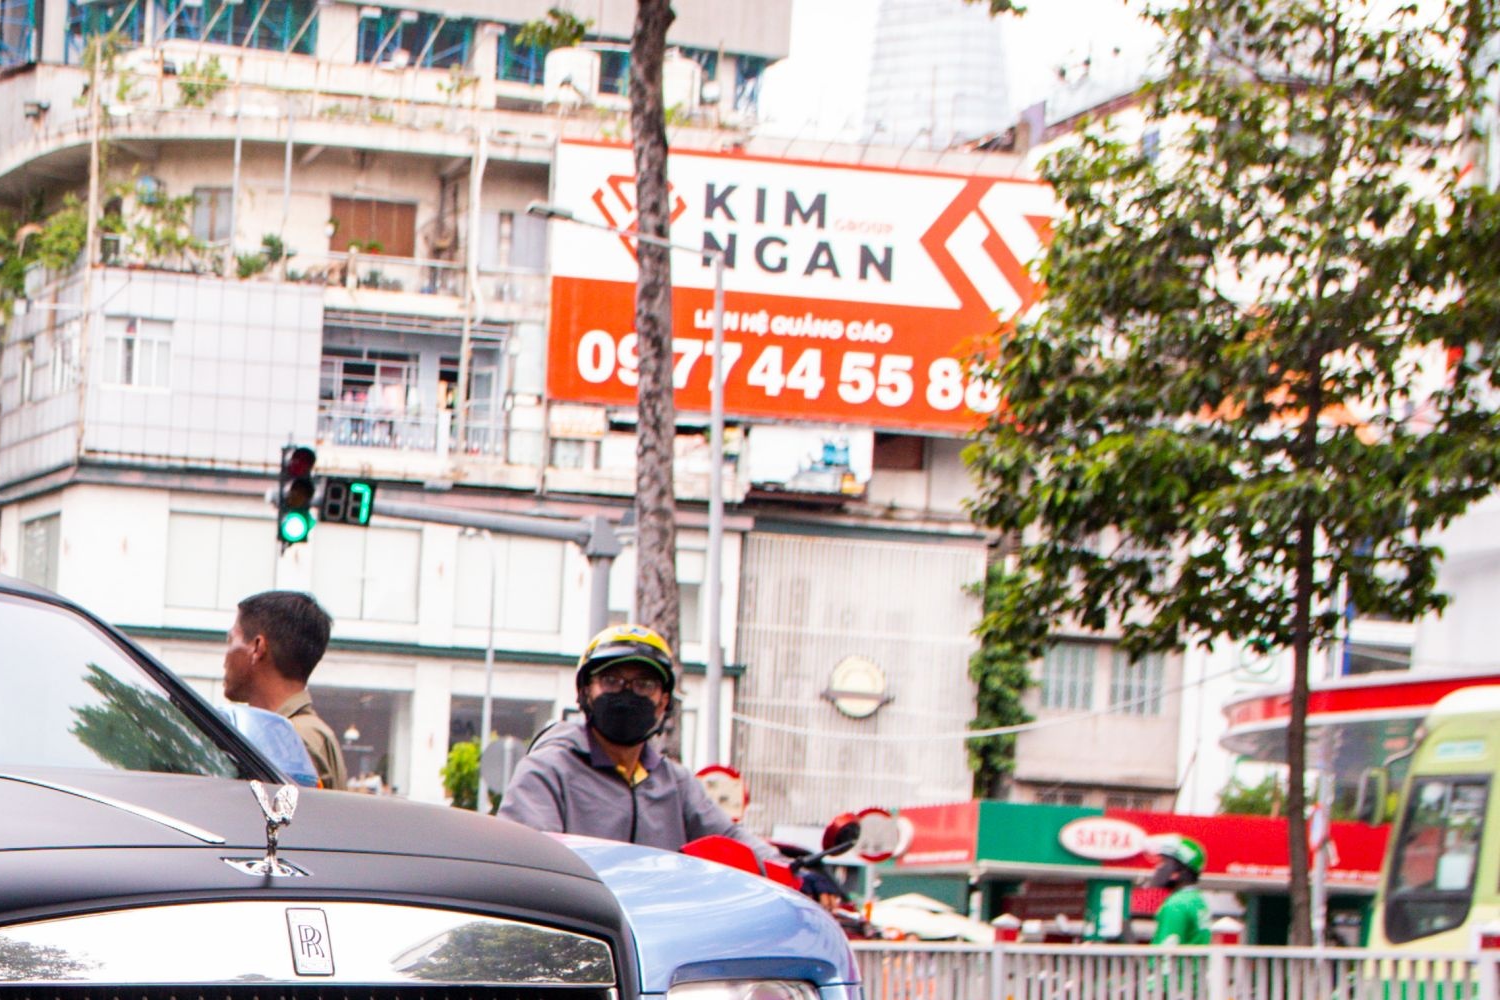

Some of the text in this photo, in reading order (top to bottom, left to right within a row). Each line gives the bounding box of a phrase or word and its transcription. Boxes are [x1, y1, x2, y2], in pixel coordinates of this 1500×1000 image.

[703, 182, 828, 230] KIM
[702, 231, 894, 284] NGAN
[694, 308, 740, 331] LIN
[746, 345, 825, 400] 44
[837, 350, 914, 407] 55
[1075, 828, 1133, 849] SATRA
